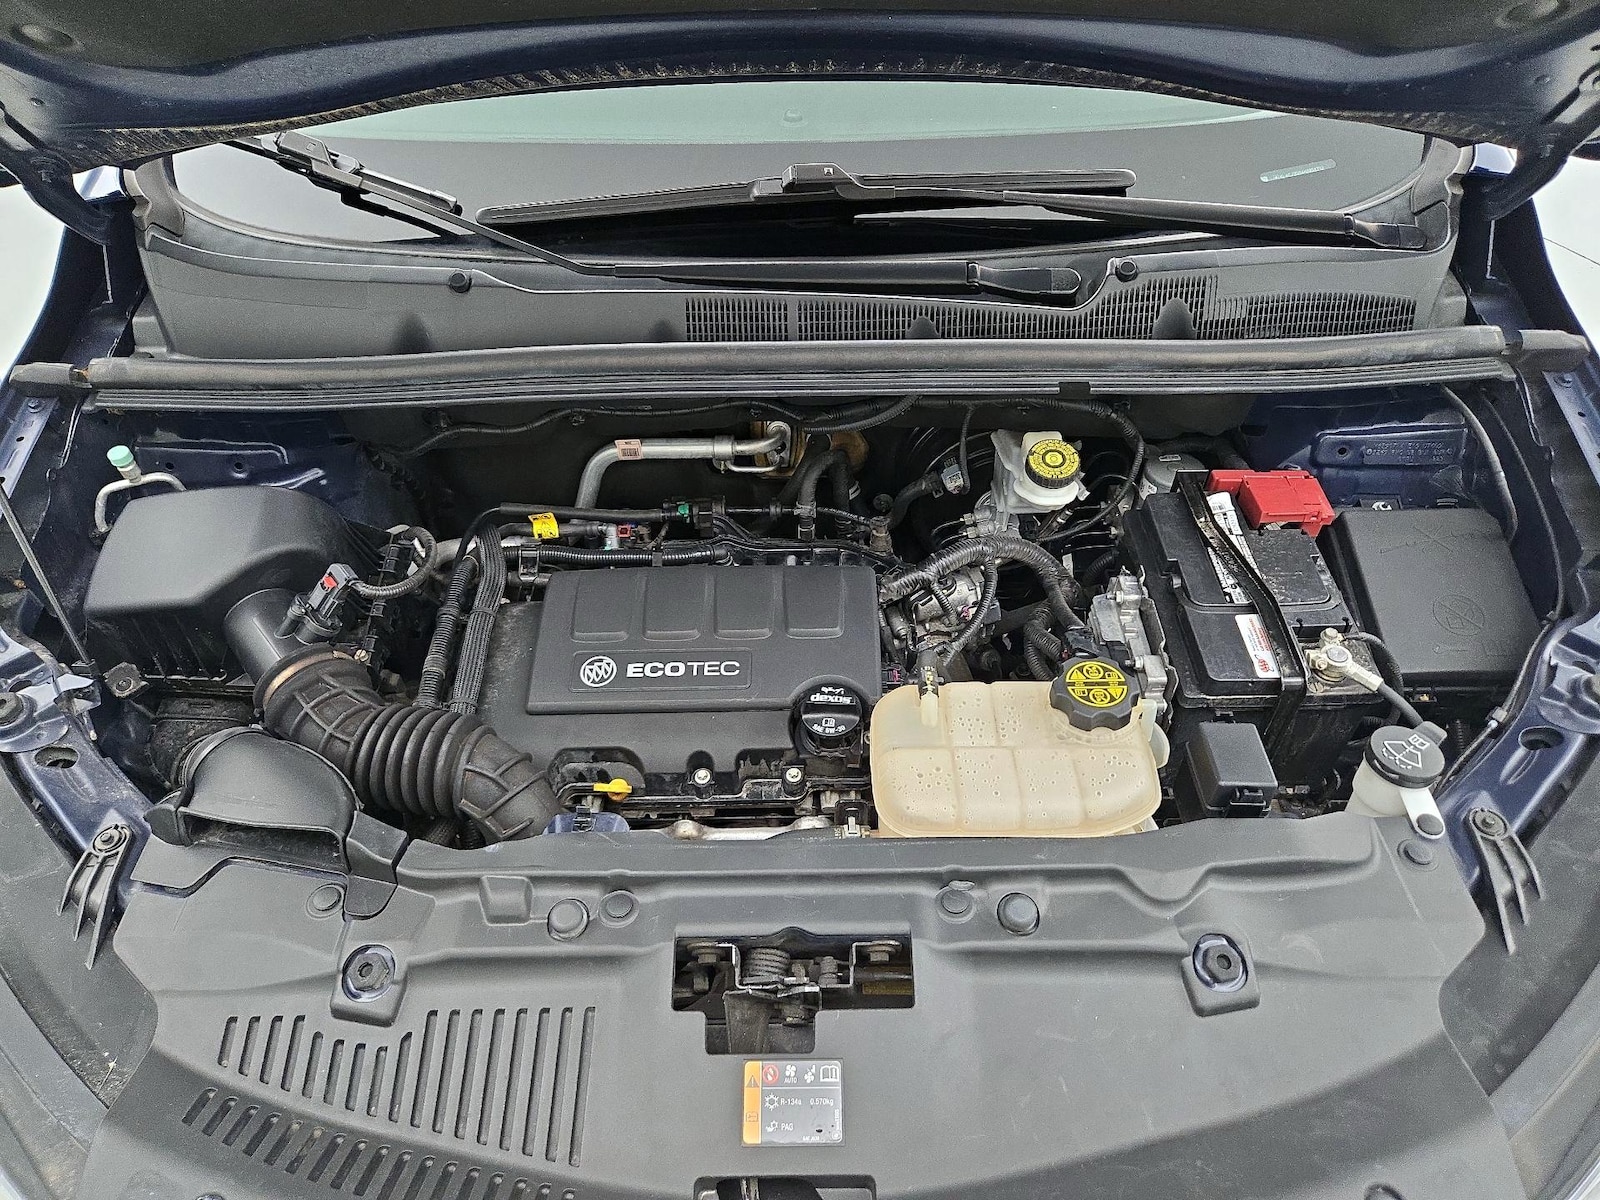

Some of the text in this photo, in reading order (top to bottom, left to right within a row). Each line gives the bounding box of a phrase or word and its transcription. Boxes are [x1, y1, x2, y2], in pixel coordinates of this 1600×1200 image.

[626, 660, 741, 678] ECOTEC
[810, 692, 853, 704] dexos
[780, 1097, 834, 1107] R-134a 0.570kg
[781, 1123, 793, 1131] PAG
